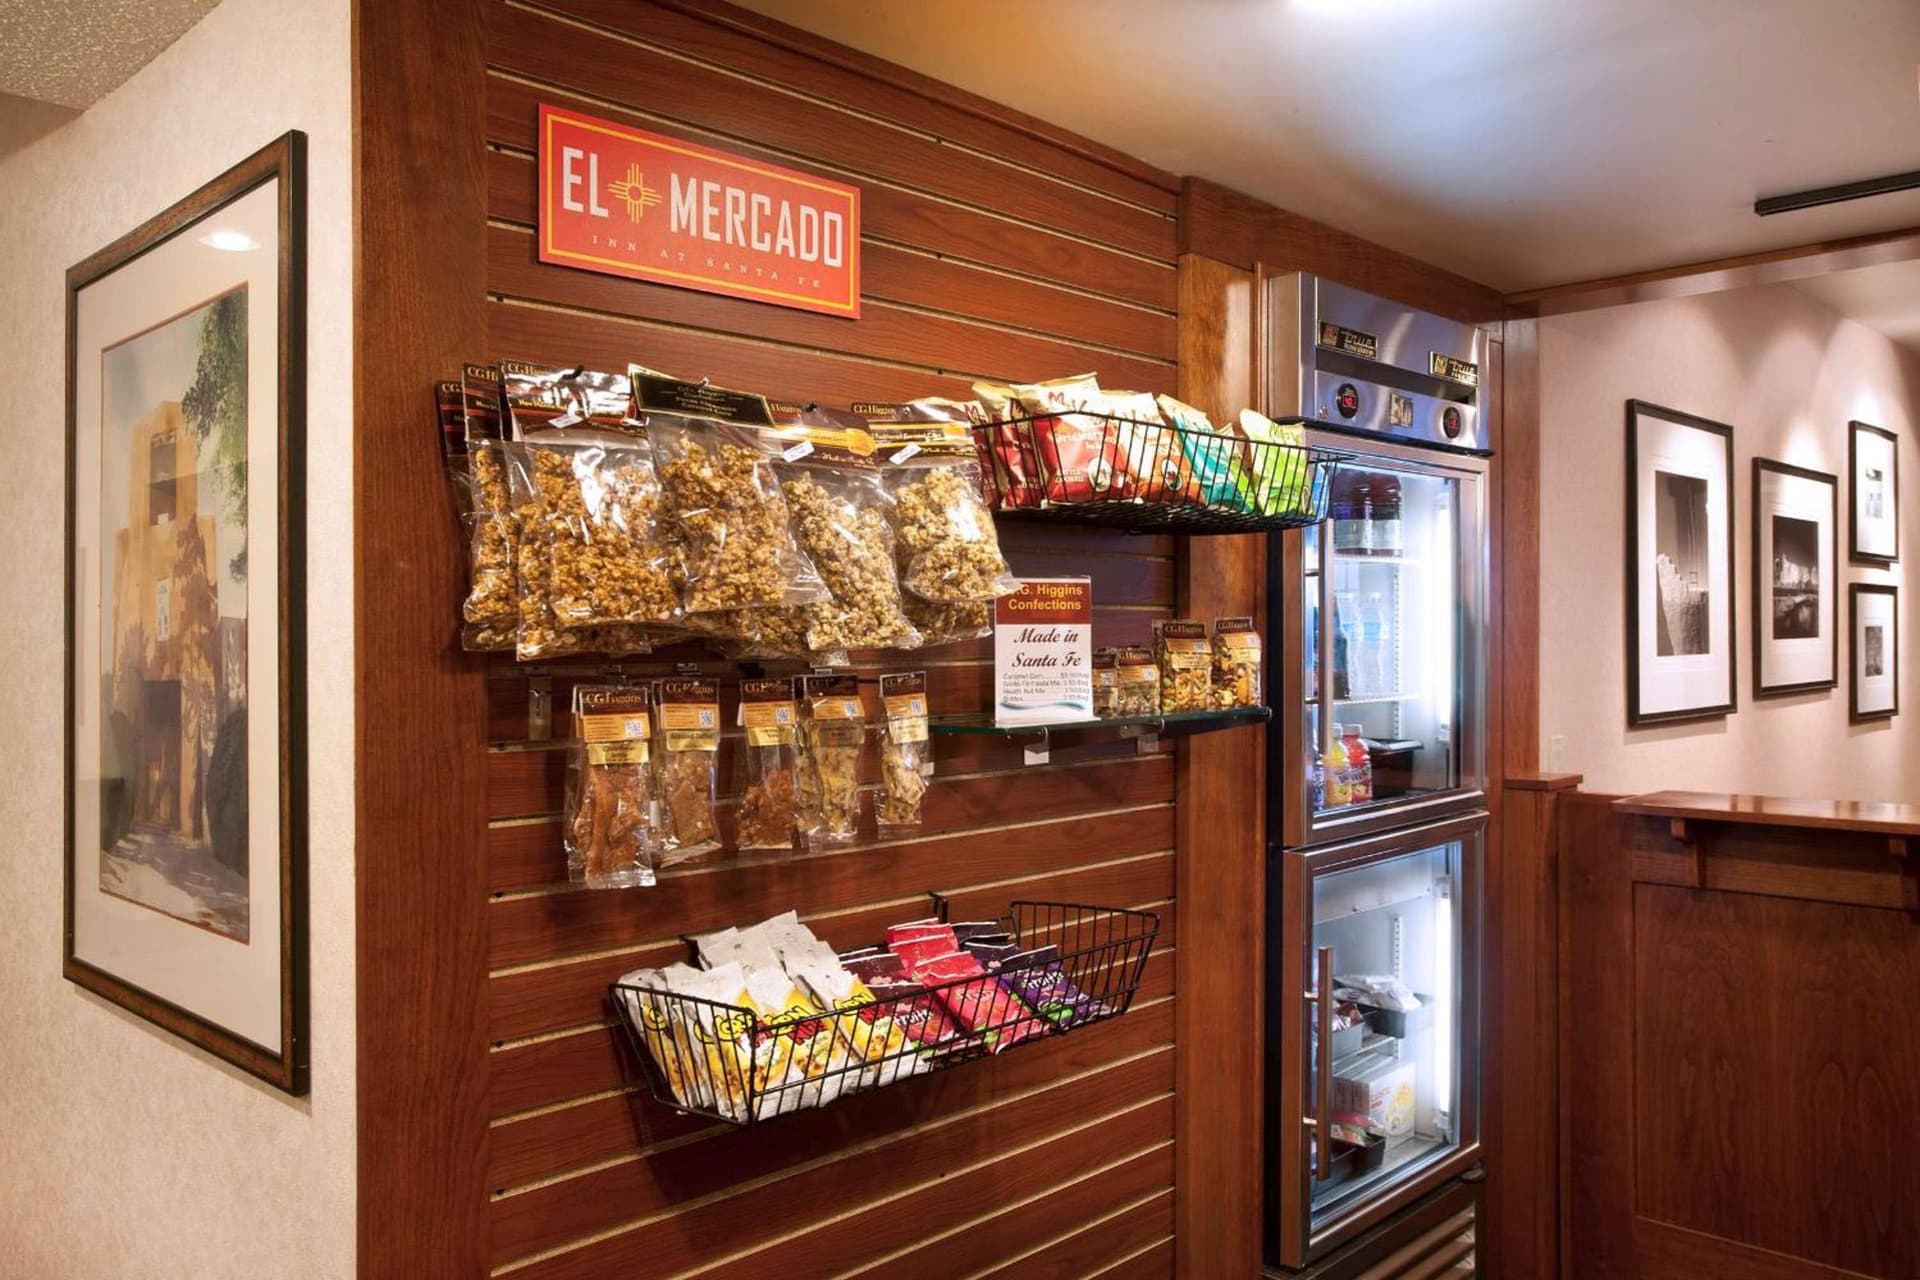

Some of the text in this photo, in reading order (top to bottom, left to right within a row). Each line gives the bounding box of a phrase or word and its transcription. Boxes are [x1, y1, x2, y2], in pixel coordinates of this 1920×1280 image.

[563, 146, 842, 268] EL MERCADO
[592, 235, 820, 288] INN AT SANTA FE
[1037, 583, 1083, 598] Higgins
[1008, 599, 1082, 610] Confections
[1013, 627, 1079, 644] Made in
[1011, 652, 1058, 668] Santa
[1061, 651, 1081, 667] Fe
